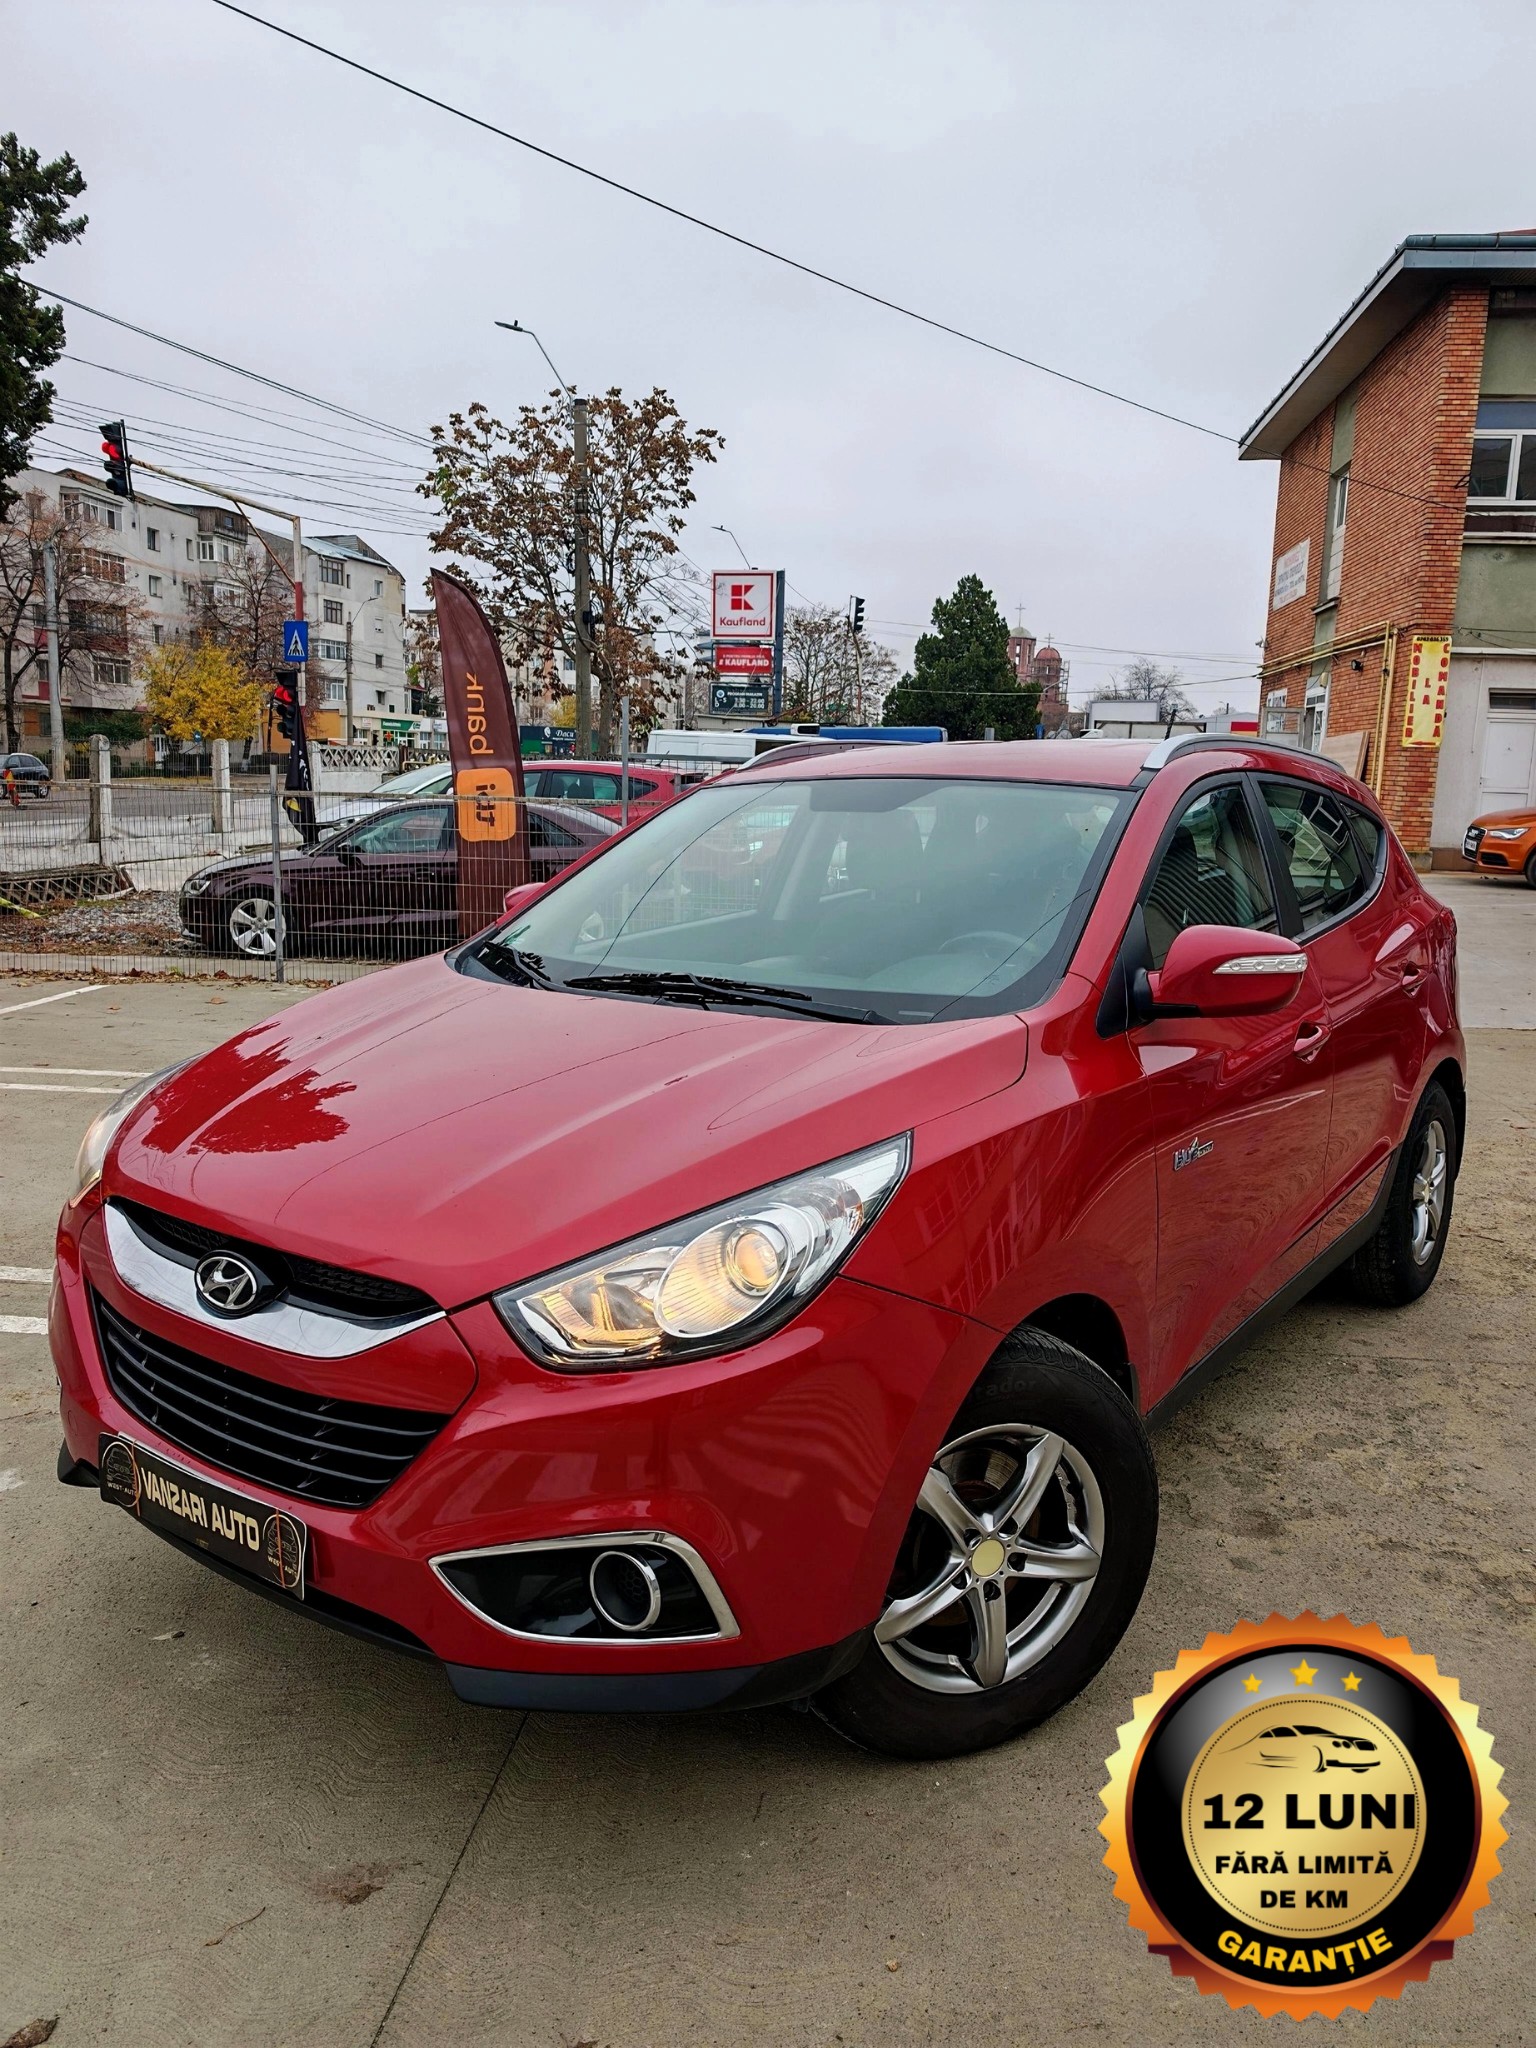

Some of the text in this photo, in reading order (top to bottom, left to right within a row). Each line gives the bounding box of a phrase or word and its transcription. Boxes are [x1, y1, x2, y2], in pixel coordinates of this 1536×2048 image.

[720, 617, 766, 626] Kaufland
[1405, 643, 1423, 738] MOBILIER
[1422, 678, 1431, 705] LA
[1433, 643, 1450, 738] COMANDA
[140, 1467, 260, 1552] VANZARI AUTO
